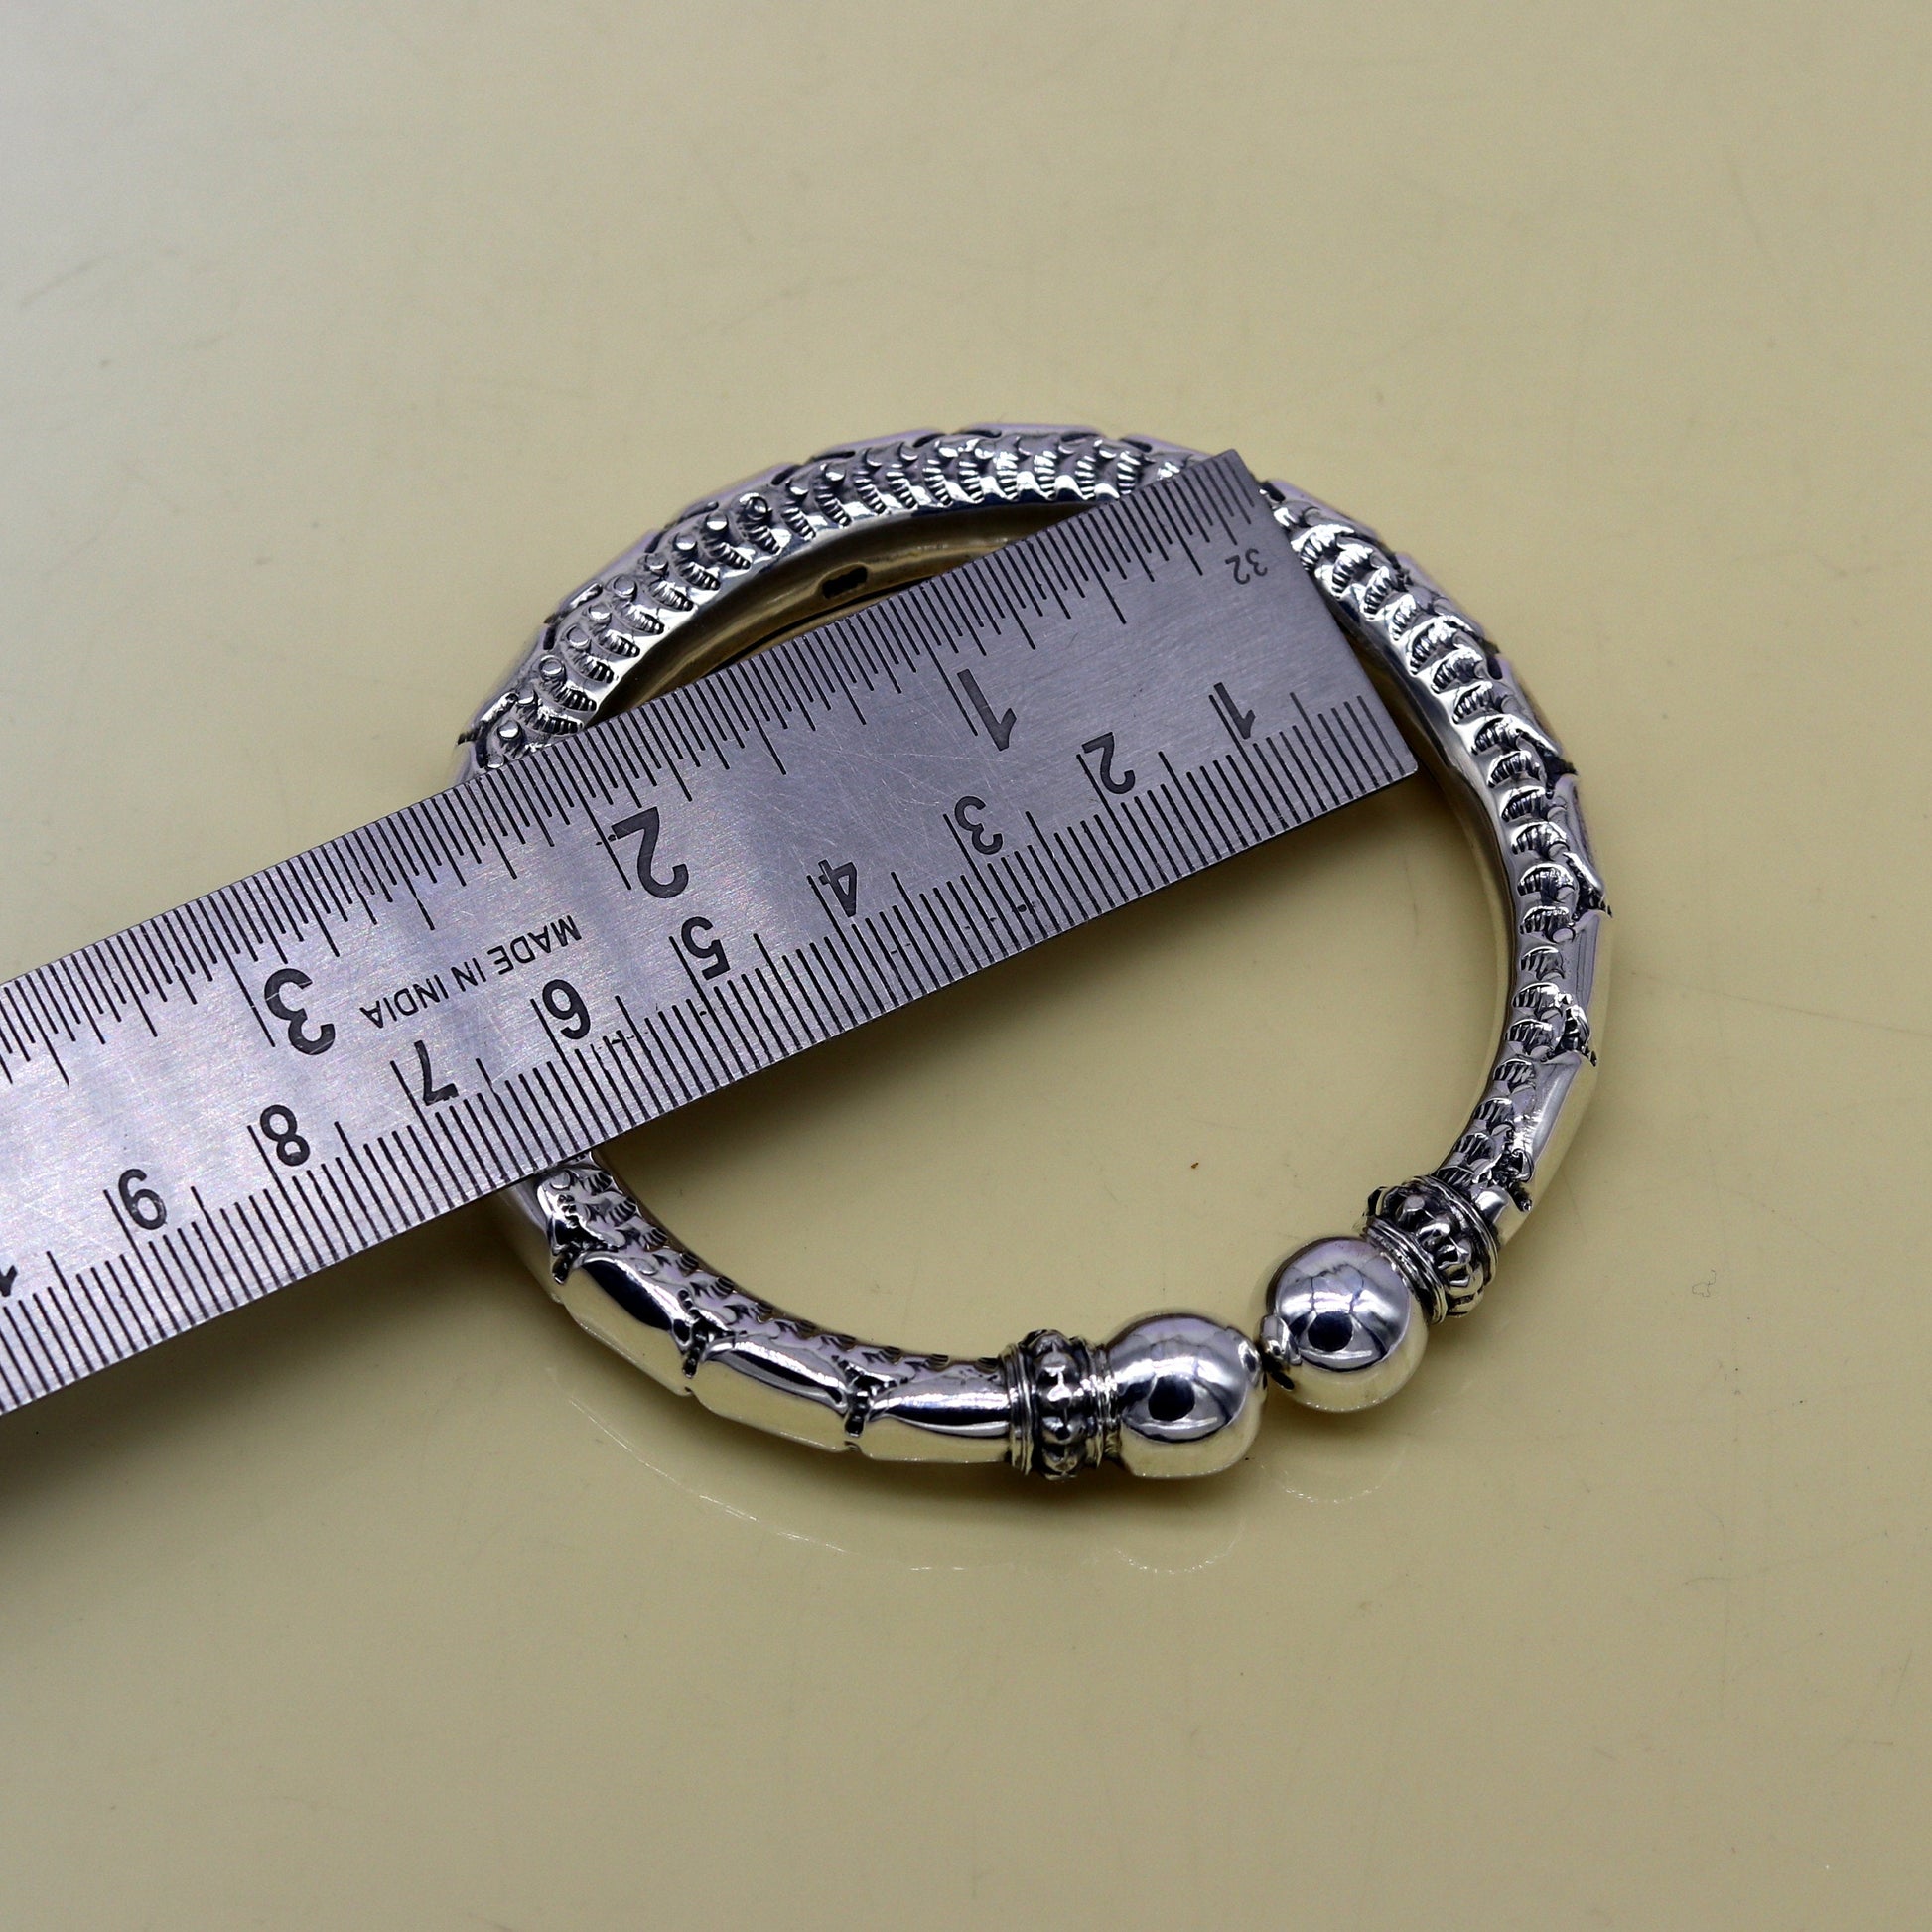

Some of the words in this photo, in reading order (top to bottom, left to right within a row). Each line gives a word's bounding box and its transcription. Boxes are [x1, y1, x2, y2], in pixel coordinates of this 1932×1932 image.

[1223, 547, 1270, 585] 32
[957, 669, 1017, 751] 1
[1213, 682, 1256, 740] 1
[1081, 732, 1136, 795] 2
[611, 806, 690, 899] 2
[953, 795, 1003, 855] 3
[818, 859, 859, 918] 4
[486, 914, 583, 975] MADE
[681, 915, 730, 980] 5
[360, 976, 451, 1030] INDIA
[450, 960, 489, 993] IN
[263, 968, 336, 1055] 3
[542, 978, 592, 1040] 6
[414, 1039, 460, 1106] 7
[259, 1104, 311, 1167] 8
[117, 1168, 167, 1231] 9
